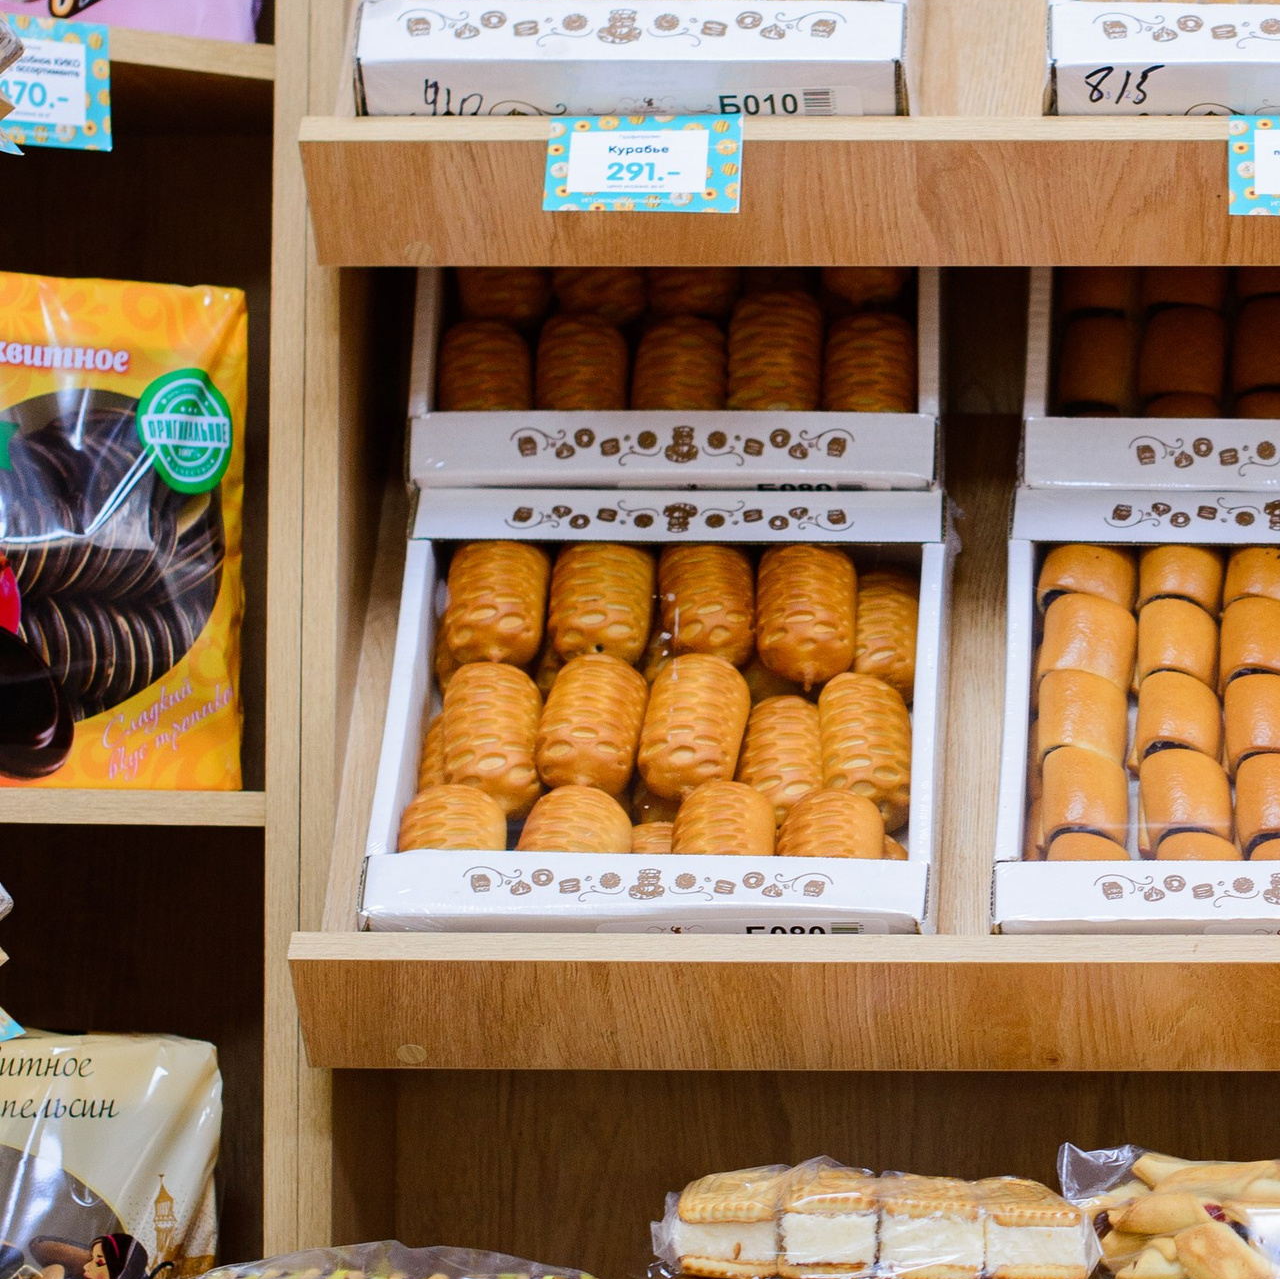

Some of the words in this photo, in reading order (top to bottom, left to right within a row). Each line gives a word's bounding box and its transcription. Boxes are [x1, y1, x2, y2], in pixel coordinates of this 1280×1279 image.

[1085, 65, 1165, 105] 815
[719, 93, 800, 116] Б010
[608, 145, 669, 156] Курабье
[606, 161, 681, 182] 291.-
[0, 1055, 96, 1078] итное
